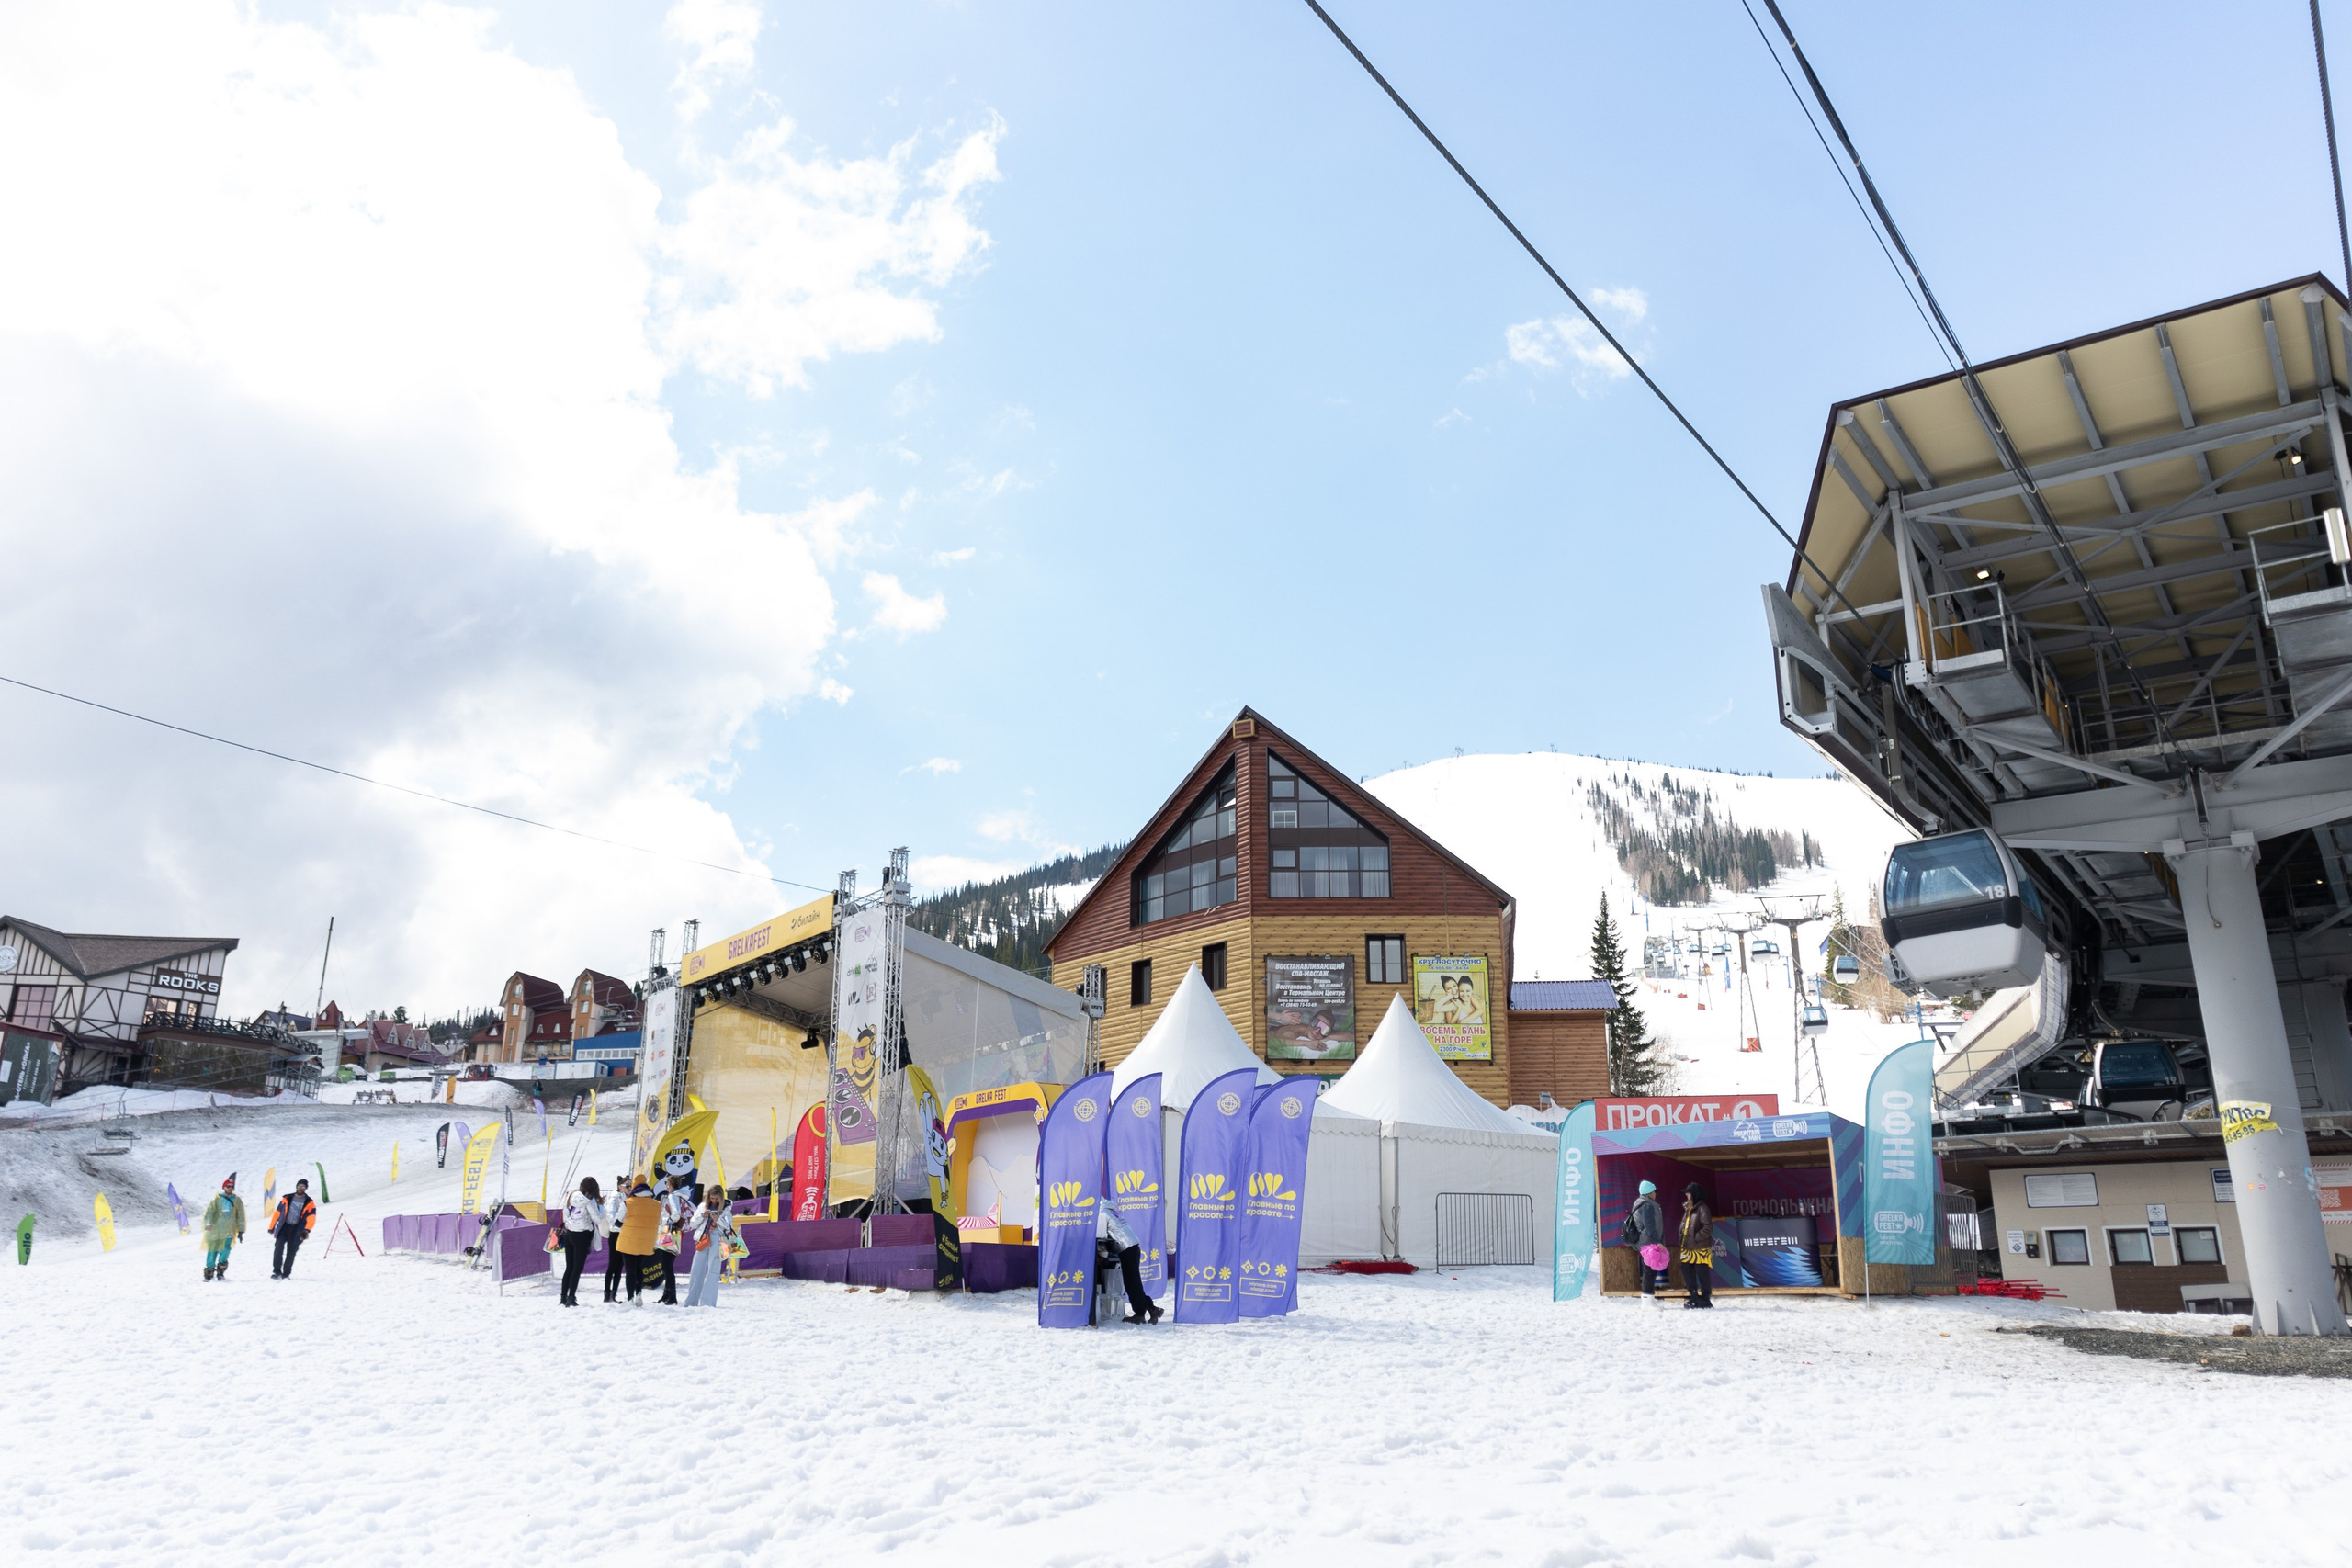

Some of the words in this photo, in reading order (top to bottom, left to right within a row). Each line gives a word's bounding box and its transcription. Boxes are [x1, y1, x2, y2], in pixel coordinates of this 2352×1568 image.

[1985, 885, 2005, 899] 18
[797, 910, 820, 927] билайн
[728, 926, 771, 960] GRELKAFEST
[1275, 962, 1345, 970] ВОССТАНАВЛИВАЮЩИЙ
[158, 975, 220, 993] ROOKS
[1419, 1026, 1456, 1034] ВОСЕМЬ
[1462, 1026, 1486, 1034] БАНЬ
[2165, 1077, 2177, 1085] 19
[976, 1091, 993, 1104] GRELKA
[994, 1089, 1007, 1100] FEST
[1606, 1103, 1720, 1131] ПРОКАТ
[1881, 1091, 1915, 1179] ИНФО
[1563, 1147, 1582, 1226] ИНФО
[1190, 1202, 1225, 1211] Главные
[1248, 1200, 1283, 1210] Главные
[1733, 1197, 1835, 1215] ГОРНОЛЫЖНА
[1049, 1211, 1082, 1219] Главные
[1188, 1212, 1224, 1220] красоте
[1246, 1209, 1283, 1218] красоте
[1879, 1213, 1903, 1222] GRELKA
[1049, 1220, 1082, 1229] красоте
[642, 1262, 662, 1275] била
